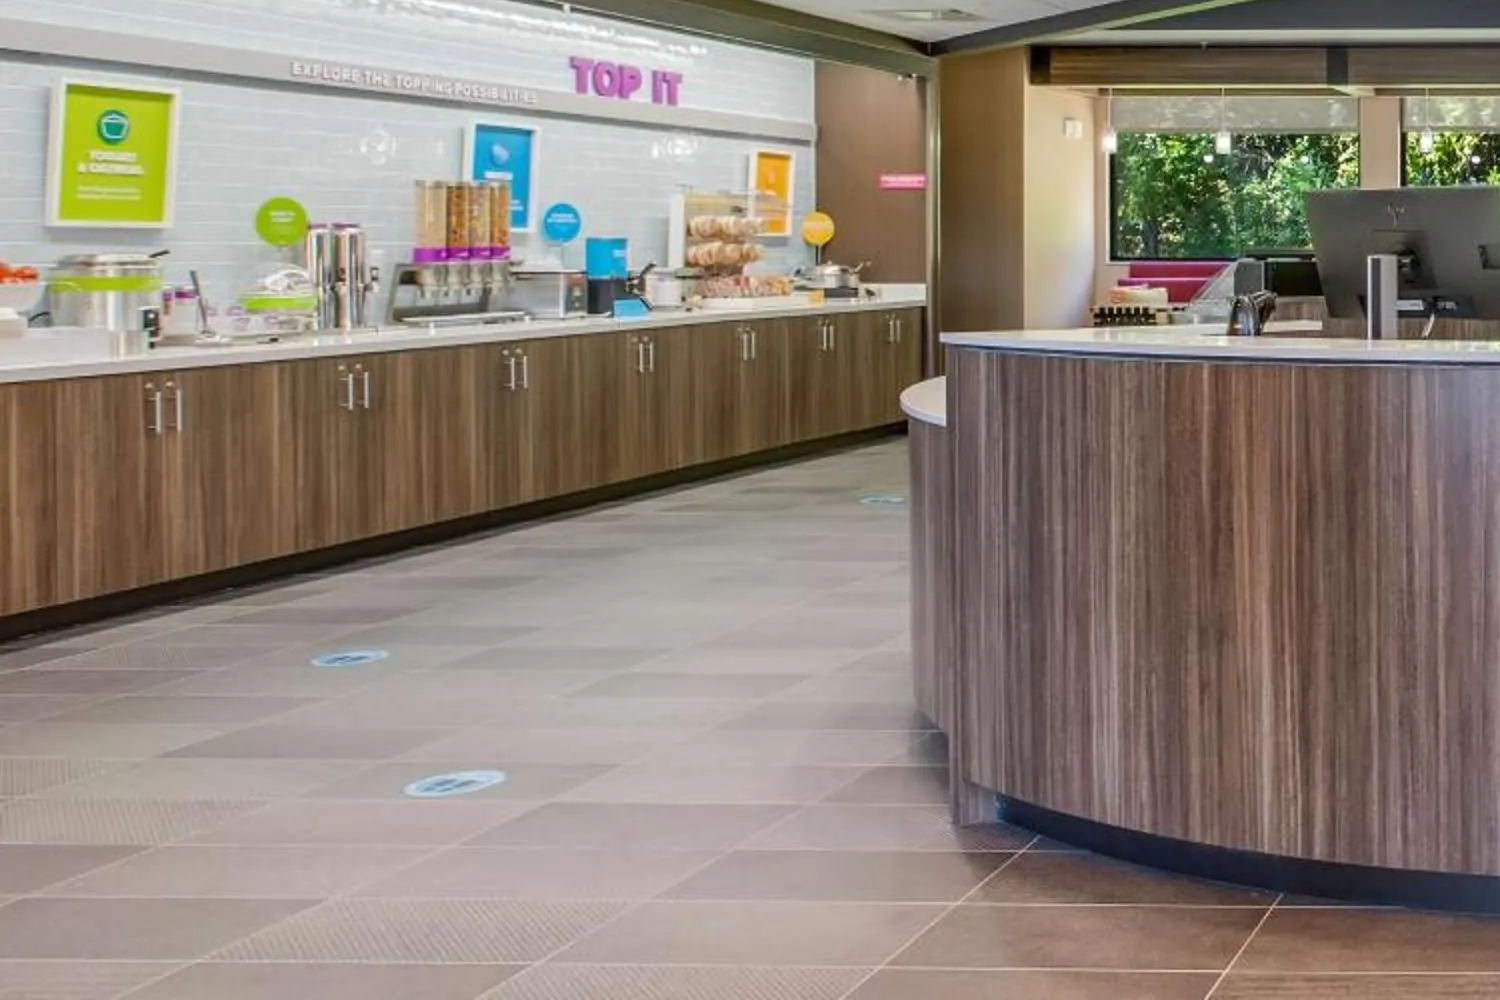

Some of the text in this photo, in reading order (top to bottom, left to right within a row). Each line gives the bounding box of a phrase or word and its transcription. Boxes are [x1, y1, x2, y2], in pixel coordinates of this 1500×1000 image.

[292, 61, 538, 104] EXPLORE THE TOPPING POSSIBILITIES
[569, 56, 683, 106] TOP IT
